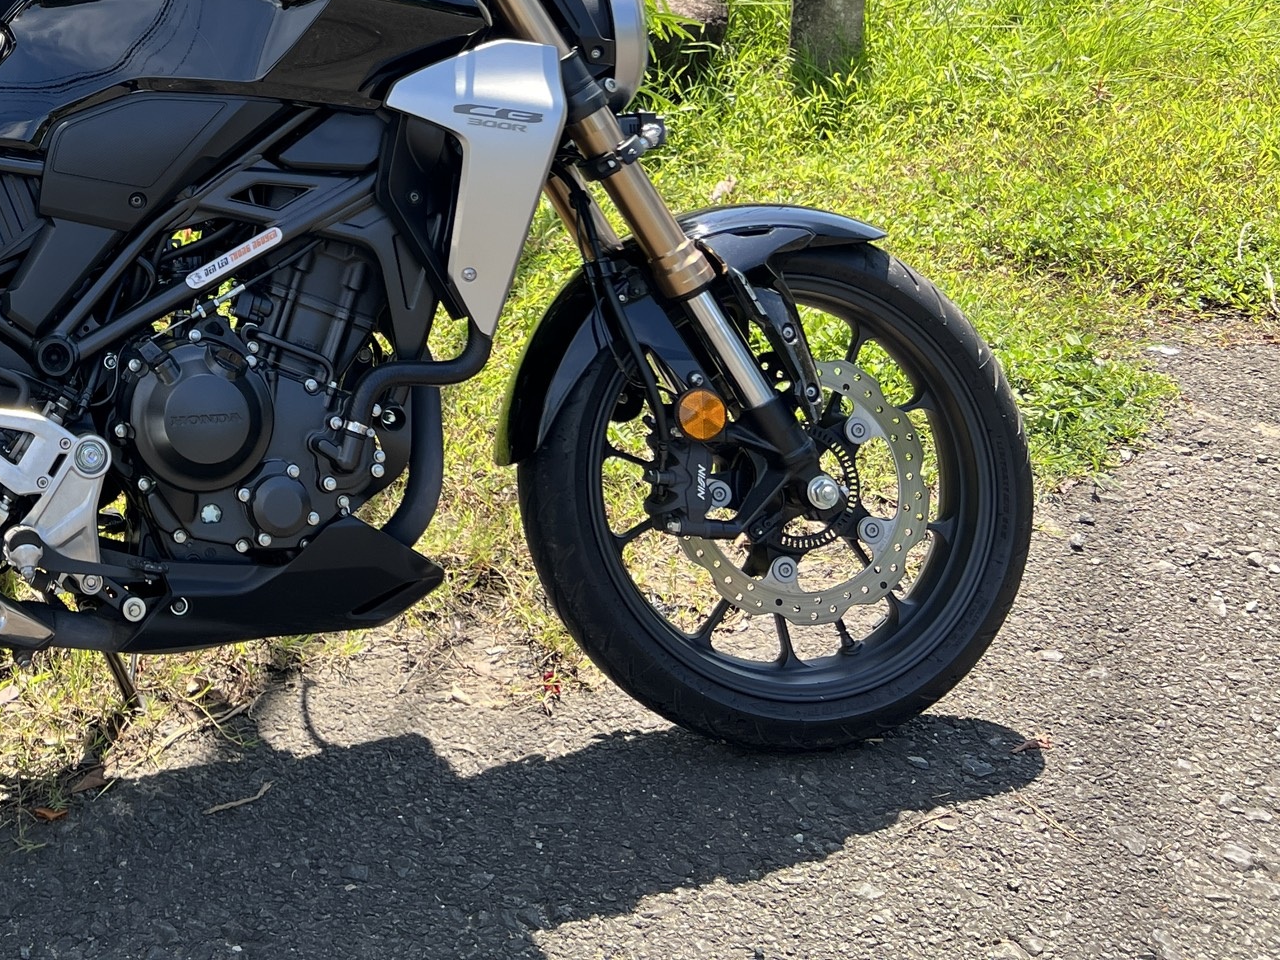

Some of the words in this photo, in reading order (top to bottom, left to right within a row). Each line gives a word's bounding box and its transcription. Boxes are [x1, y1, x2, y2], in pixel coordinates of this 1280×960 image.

[453, 103, 544, 124] CB
[467, 117, 529, 133] 300R
[170, 412, 243, 426] HONDA
